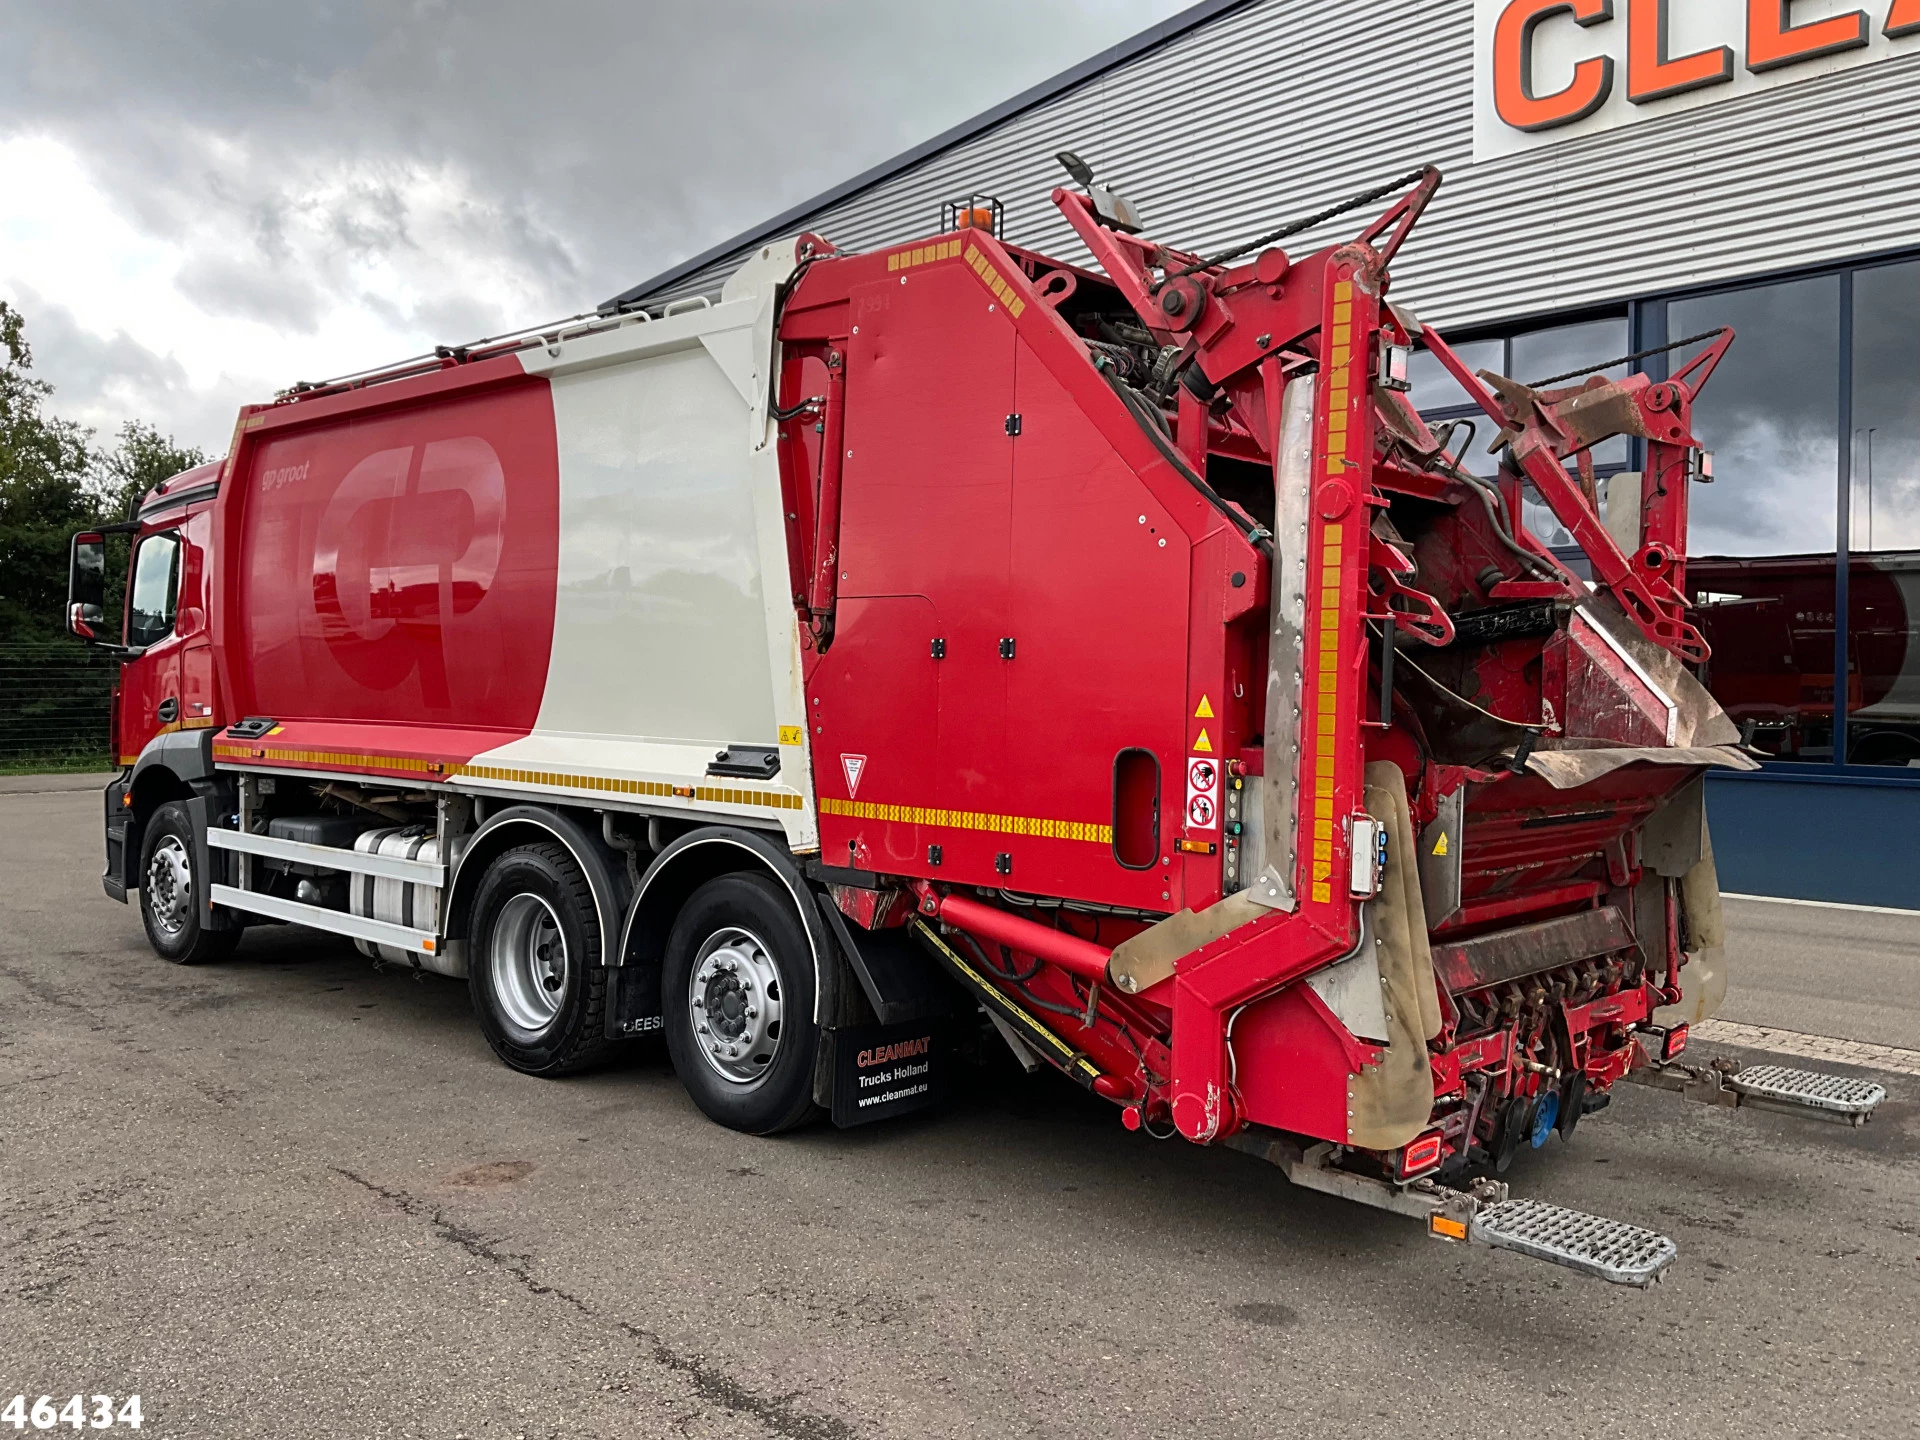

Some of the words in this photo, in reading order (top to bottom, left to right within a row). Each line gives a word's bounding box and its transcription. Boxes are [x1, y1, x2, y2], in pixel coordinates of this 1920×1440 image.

[857, 1036, 931, 1068] CLEANMAT
[859, 1071, 892, 1088] Trucks
[894, 1061, 929, 1080] Holland
[858, 1083, 928, 1108] www.cleanmat.eu
